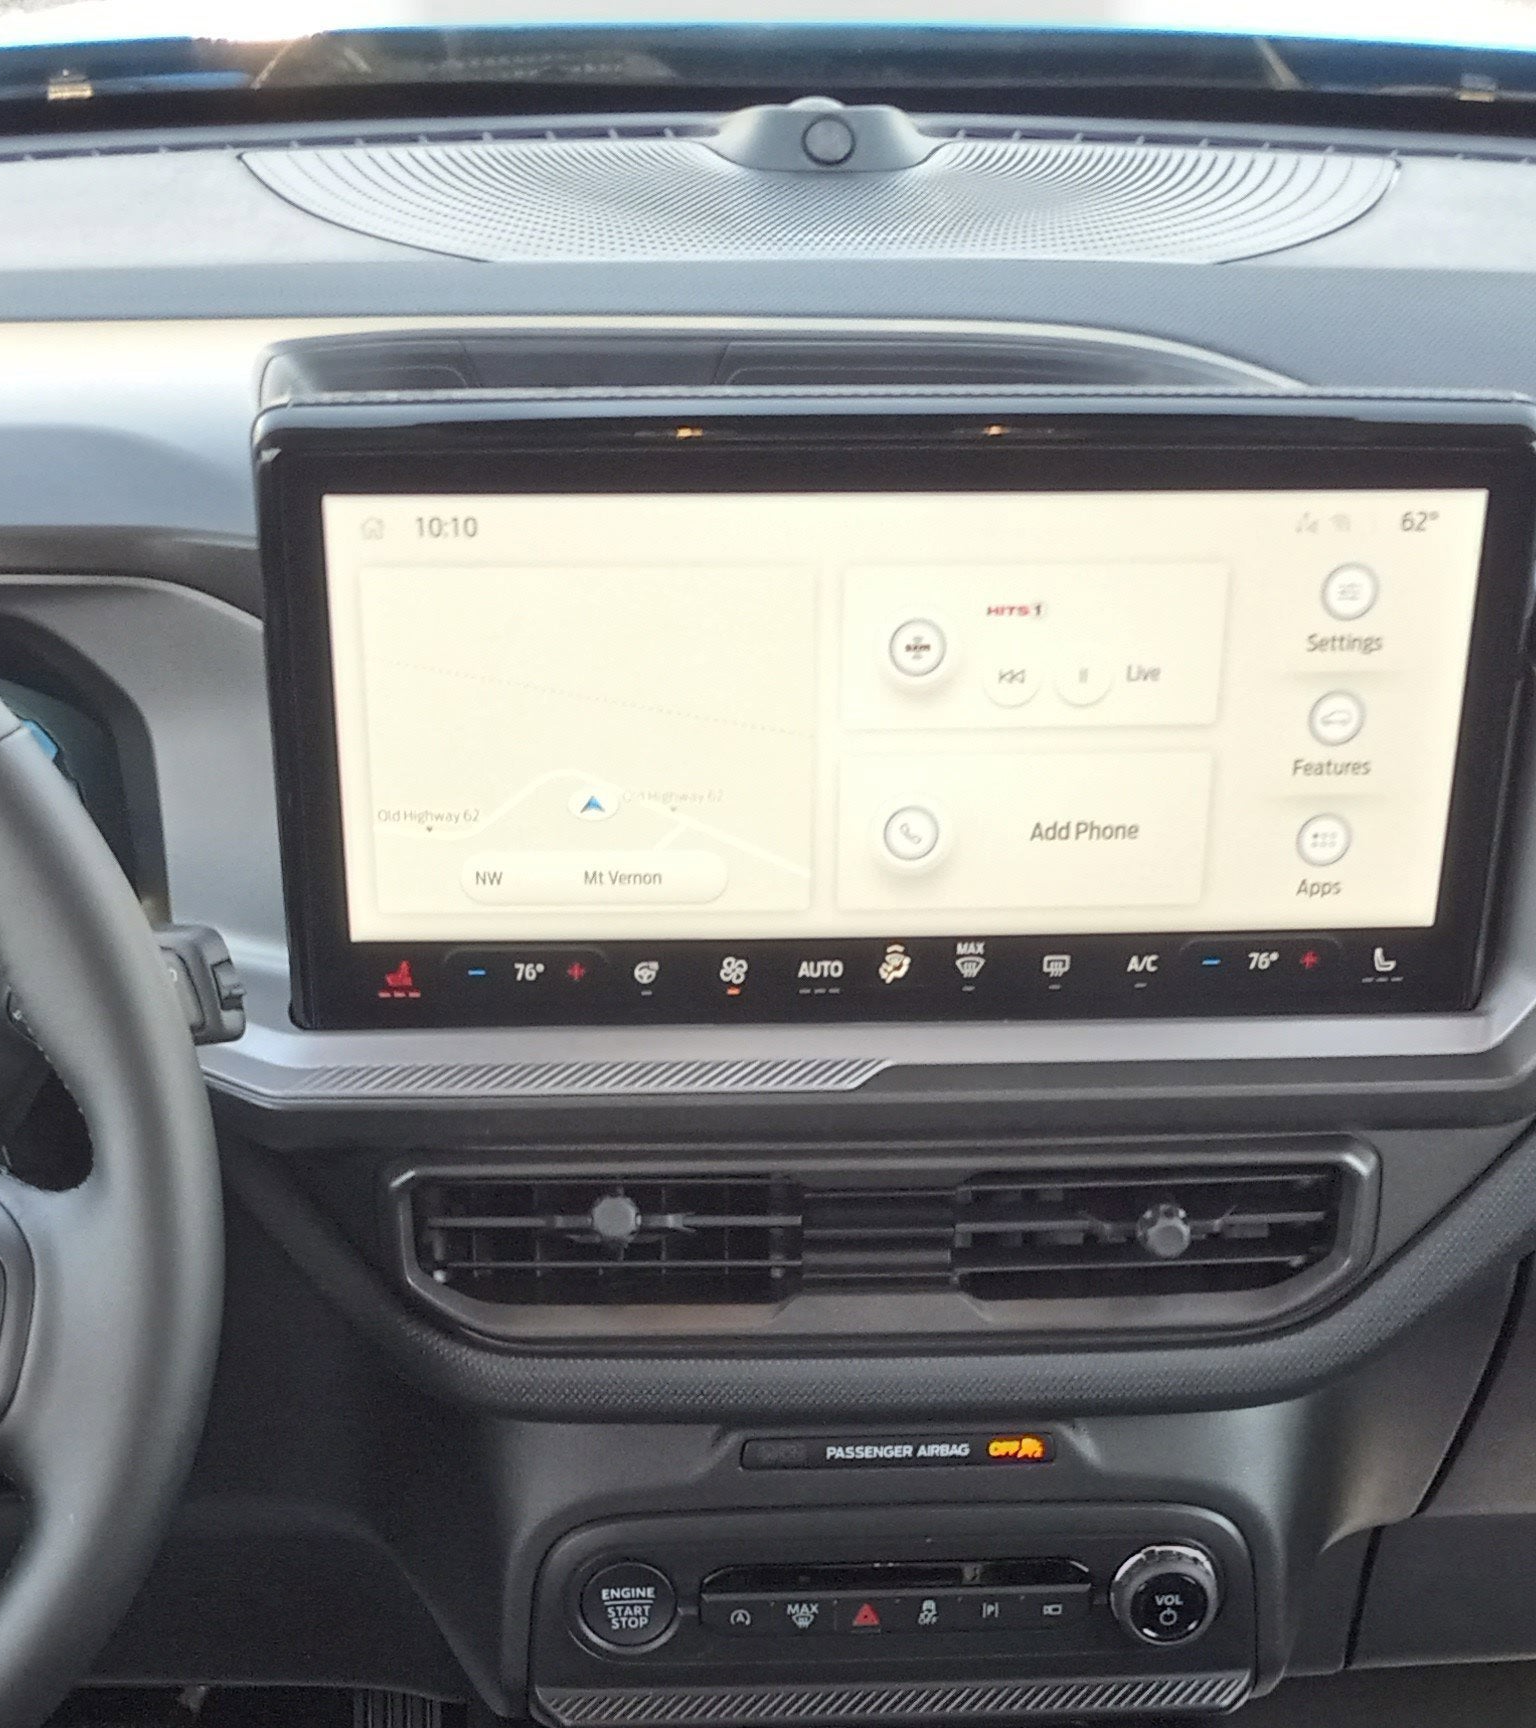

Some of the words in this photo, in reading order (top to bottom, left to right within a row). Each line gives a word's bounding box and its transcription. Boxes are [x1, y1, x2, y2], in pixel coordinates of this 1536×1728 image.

[414, 516, 479, 539] 10:10
[1306, 633, 1383, 655] Settings
[1126, 664, 1161, 682] Live
[1293, 758, 1371, 777] Features
[377, 808, 402, 823] Old
[403, 808, 460, 826] Highway
[462, 809, 481, 823] 62
[1029, 820, 1071, 842] Add
[1075, 820, 1140, 842] Phone
[475, 870, 503, 886] NW
[584, 870, 605, 886] Mt
[608, 870, 663, 886] Vernon
[1296, 878, 1343, 899] Apps
[956, 942, 985, 955] MAX
[798, 960, 844, 979] AUTO
[1127, 955, 1159, 974] A/C
[1248, 951, 1279, 970] 76°
[514, 962, 545, 981] 76°
[826, 1444, 913, 1459] PASSENGER
[916, 1443, 971, 1458] AIRBAG
[601, 1586, 656, 1599] ENGINE
[1154, 1594, 1183, 1606] VOL
[607, 1605, 652, 1617] START
[787, 1603, 819, 1614] MAX
[611, 1617, 649, 1630] STOP
